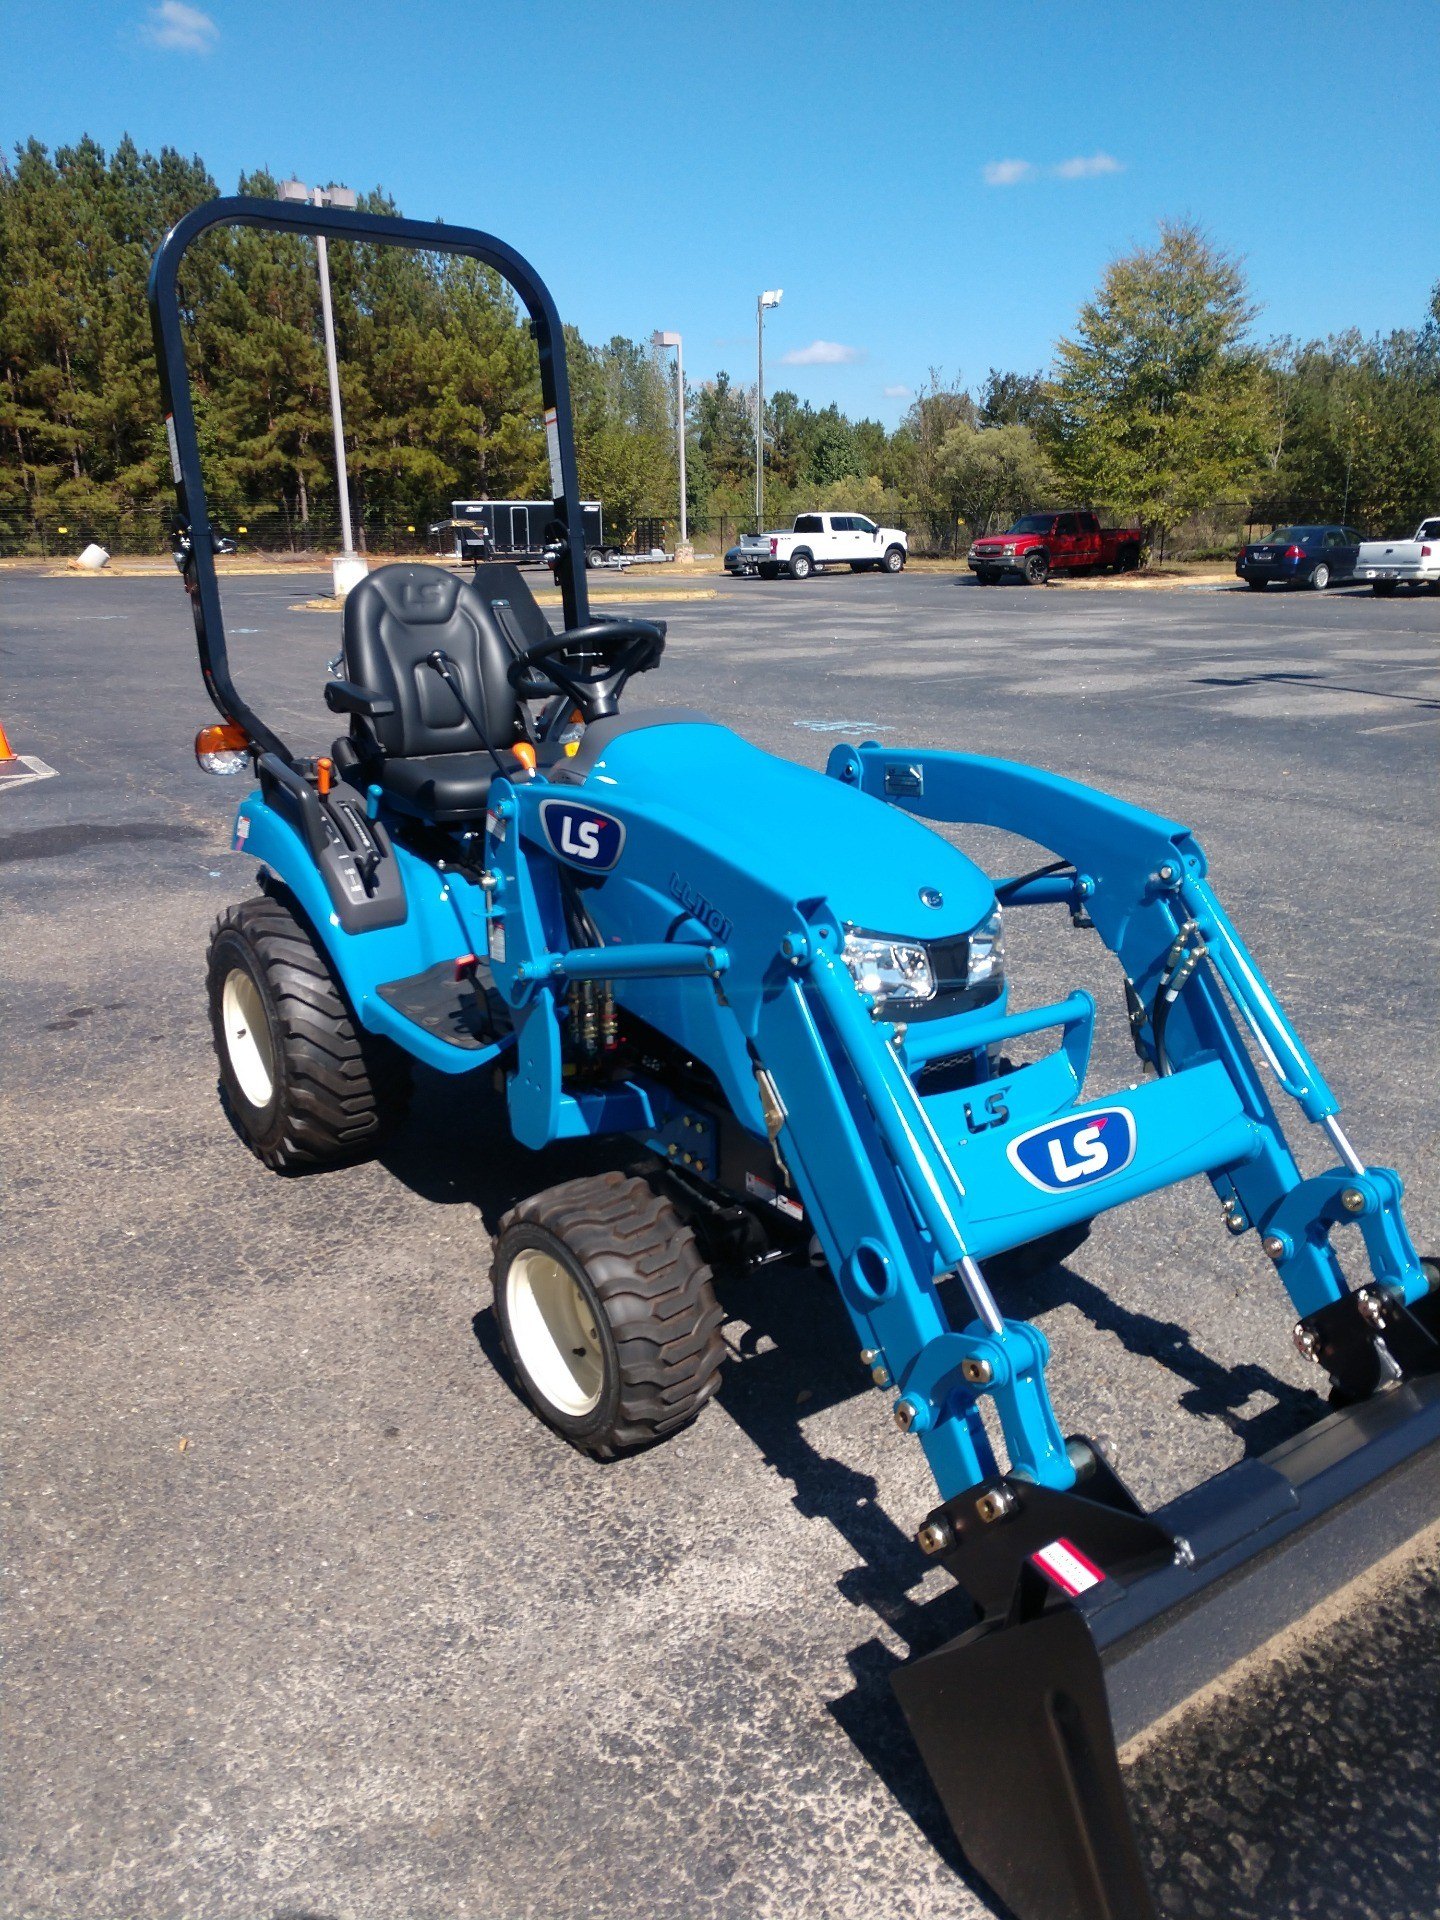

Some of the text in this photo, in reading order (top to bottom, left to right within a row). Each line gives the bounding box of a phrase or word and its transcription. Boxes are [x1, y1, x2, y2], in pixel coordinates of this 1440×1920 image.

[399, 582, 446, 609] LS
[561, 815, 600, 860] LS
[963, 1092, 1010, 1135] LS
[1048, 1126, 1109, 1183] LS
